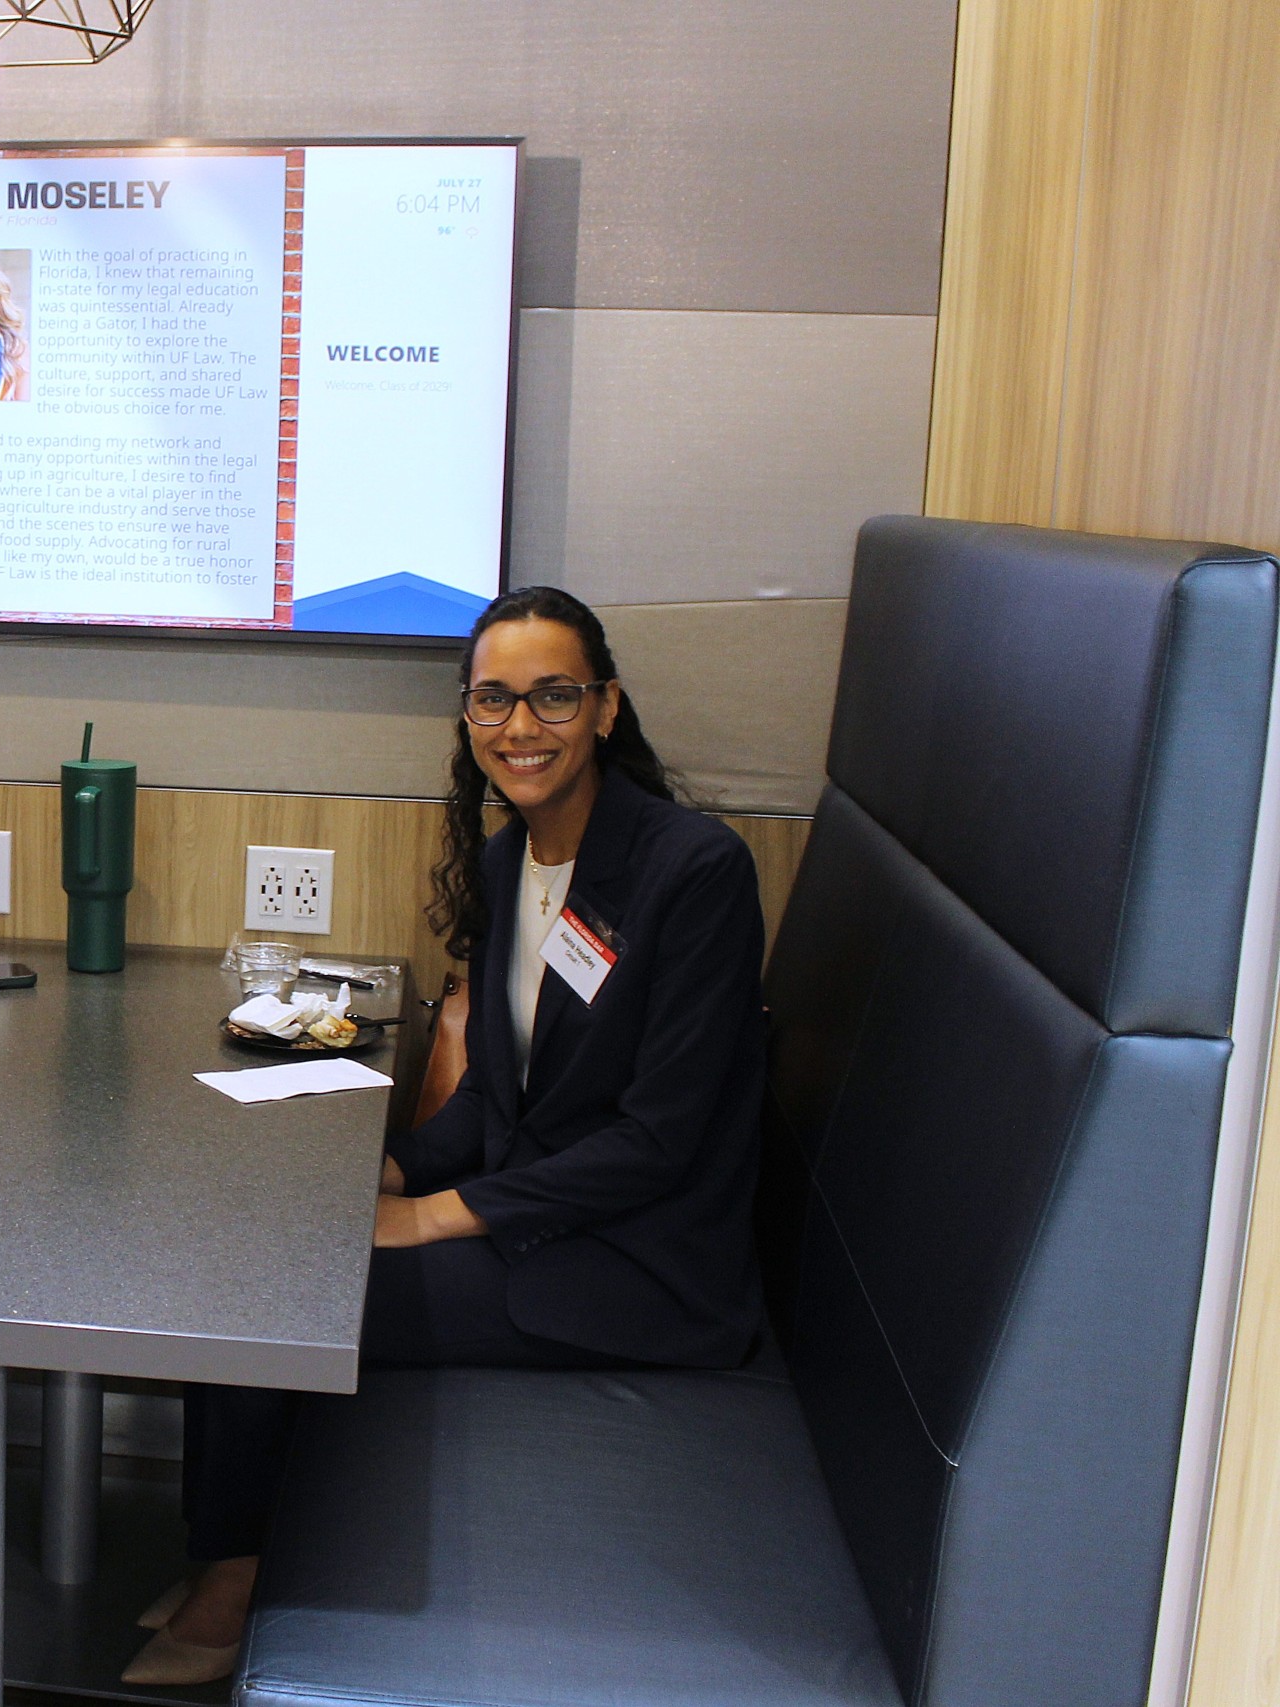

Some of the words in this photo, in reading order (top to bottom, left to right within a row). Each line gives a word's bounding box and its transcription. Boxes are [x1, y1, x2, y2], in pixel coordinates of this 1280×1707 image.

[436, 178, 464, 188] JULY
[468, 178, 482, 188] 27
[7, 181, 171, 210] MOSELEY
[396, 194, 439, 214] 6:04
[448, 194, 480, 214] PM
[7, 216, 57, 226] Florida
[39, 248, 71, 262] With
[76, 248, 99, 261] the
[103, 248, 134, 265] goal
[138, 248, 154, 261] of
[157, 248, 229, 265] practicing
[234, 248, 246, 261] in
[39, 265, 90, 280] Florida,
[105, 265, 142, 278] knew
[146, 265, 175, 278] that
[179, 265, 253, 282] remaining
[39, 283, 91, 295] in-state
[96, 282, 117, 295] for
[121, 286, 143, 299] my
[147, 282, 181, 299] legal
[185, 282, 258, 295] education
[38, 302, 65, 312] was
[69, 299, 174, 316] quintessential.
[178, 299, 233, 316] Already
[38, 316, 78, 333] being
[95, 316, 136, 331] Gator,
[151, 316, 178, 330] had
[182, 316, 206, 330] the
[38, 334, 122, 350] opportunity
[126, 335, 140, 346] to
[145, 333, 199, 350] explore
[203, 334, 227, 347] the
[38, 350, 117, 367] community
[121, 350, 165, 364] within
[169, 350, 189, 364] UF
[193, 350, 224, 364] Law.
[228, 351, 256, 364] The
[326, 345, 440, 363] WELCOME
[37, 367, 90, 382] culture,
[95, 368, 154, 384] support,
[159, 367, 186, 381] and
[191, 368, 241, 381] shared
[37, 383, 80, 397] desire
[85, 384, 104, 397] for
[110, 387, 165, 397] success
[169, 384, 210, 398] made
[215, 385, 234, 398] UF
[239, 385, 268, 398] Law
[380, 380, 406, 392] Class
[408, 381, 420, 392] of
[37, 400, 60, 413] the
[64, 400, 119, 414] obvious
[124, 401, 170, 414] choice
[174, 401, 195, 415] for
[199, 405, 225, 415] me.
[8, 435, 22, 446] to
[26, 434, 100, 451] expanding
[106, 438, 127, 451] my
[131, 435, 190, 448] network
[193, 435, 221, 449] and
[4, 453, 42, 467] many
[46, 451, 142, 468] opportunities
[146, 452, 190, 465] within
[194, 452, 218, 466] the
[222, 453, 256, 470] legal
[7, 470, 25, 483] up
[30, 467, 42, 480] in
[46, 467, 127, 485] agriculture,
[141, 468, 185, 482] desire
[189, 471, 204, 482] to
[208, 470, 236, 483] find
[55, 487, 80, 497] can
[85, 484, 102, 498] be
[119, 485, 147, 498] vital
[152, 486, 197, 503] player
[201, 487, 213, 500] in
[218, 487, 241, 500] the
[79, 501, 136, 518] industry
[140, 502, 167, 516] and
[171, 506, 211, 516] serve
[215, 504, 256, 517] those
[19, 517, 41, 530] the
[46, 520, 94, 531] scenes
[98, 520, 113, 531] to
[117, 522, 166, 532] ensure
[170, 523, 191, 533] we
[195, 520, 230, 534] have
[35, 534, 83, 551] supply.
[88, 535, 167, 552] Advocating
[172, 536, 193, 550] for
[196, 537, 230, 550] rural
[4, 549, 26, 562] like
[31, 553, 52, 567] my
[55, 554, 88, 566] own,
[93, 551, 135, 565] would
[140, 552, 158, 566] be
[175, 555, 204, 567] true
[209, 554, 254, 568] honor
[9, 566, 36, 579] Law
[40, 567, 50, 580] is
[55, 567, 78, 580] the
[82, 568, 115, 581] ideal
[120, 569, 191, 583] institution
[196, 572, 211, 584] to
[215, 571, 258, 585] foster
